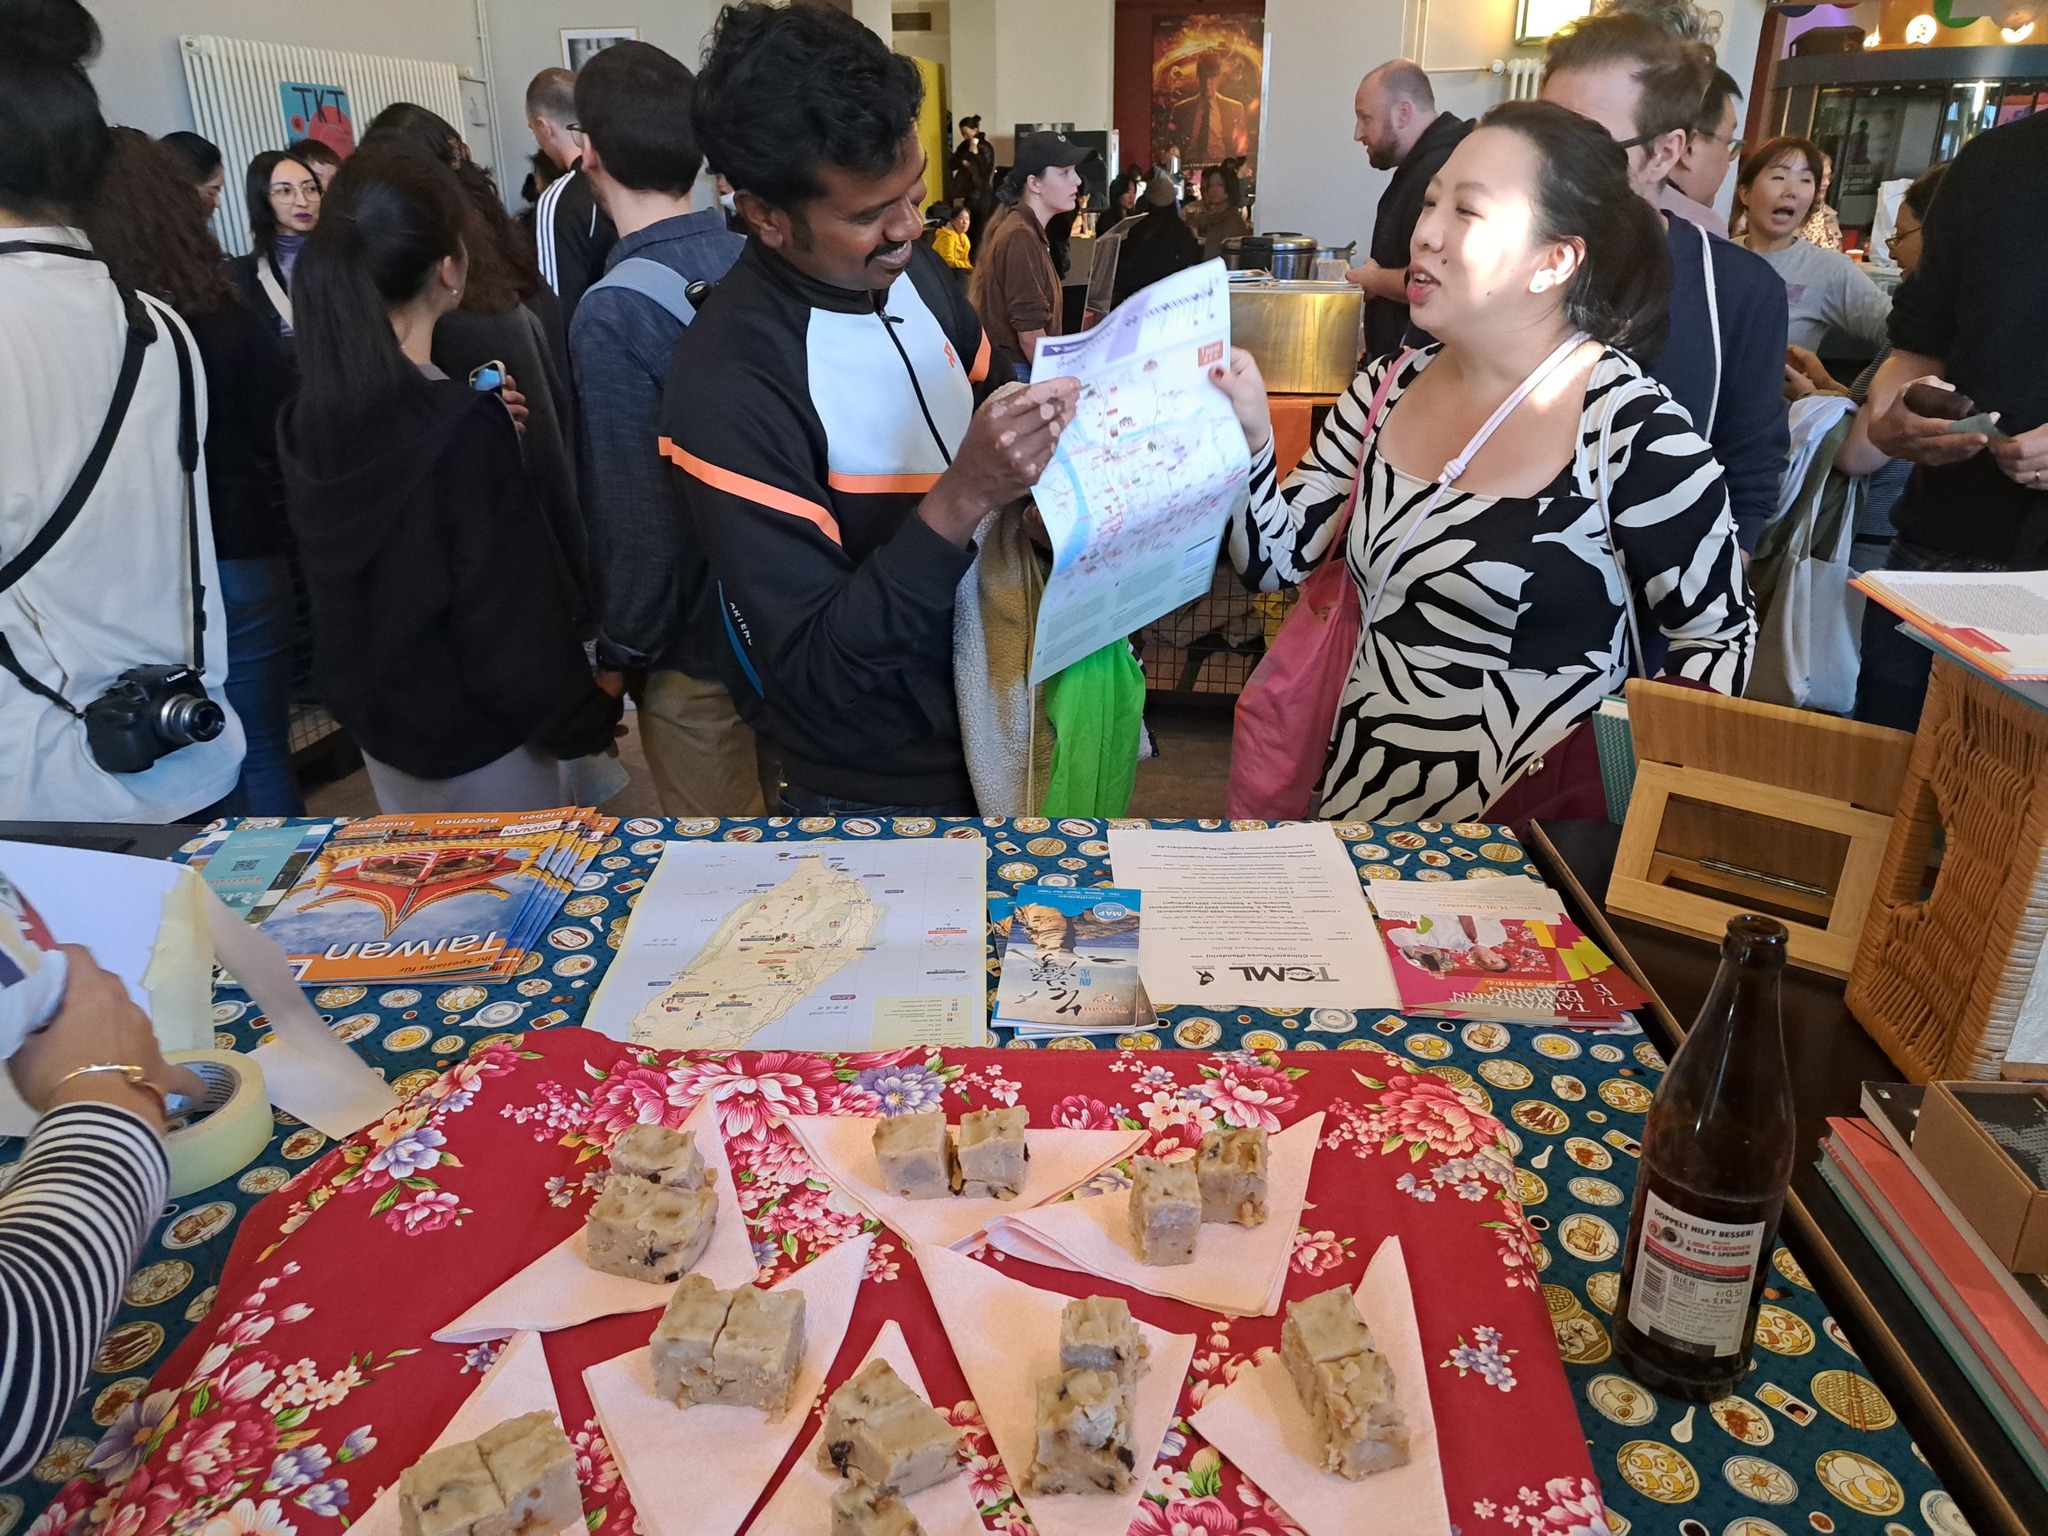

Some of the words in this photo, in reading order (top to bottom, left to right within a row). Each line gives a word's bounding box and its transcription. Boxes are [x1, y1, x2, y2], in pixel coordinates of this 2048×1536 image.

[291, 86, 345, 124] TKT
[435, 816, 500, 826] Begegnen
[518, 810, 568, 822] Erleben
[348, 820, 416, 829] Entdecken
[502, 823, 558, 835] TAIWAN
[324, 931, 502, 961] Taiwan
[418, 958, 473, 972] Spezialist
[476, 956, 492, 964] Ihr
[398, 966, 418, 974] für
[1228, 966, 1341, 983] TCML
[1451, 991, 1556, 1004] MANDARIN
[1488, 986, 1581, 1000] LEARNING
[1449, 997, 1502, 1007] CENTER
[1508, 1000, 1591, 1013] TAIWAN
[1653, 1208, 1690, 1231] DOPPELT
[1690, 1225, 1717, 1238] HILFT
[1718, 1230, 1754, 1239] BESSER!
[1712, 1244, 1752, 1252] GEWINNEN
[1717, 1250, 1750, 1258] SPENDEN
[1672, 1274, 1696, 1288] BIER
